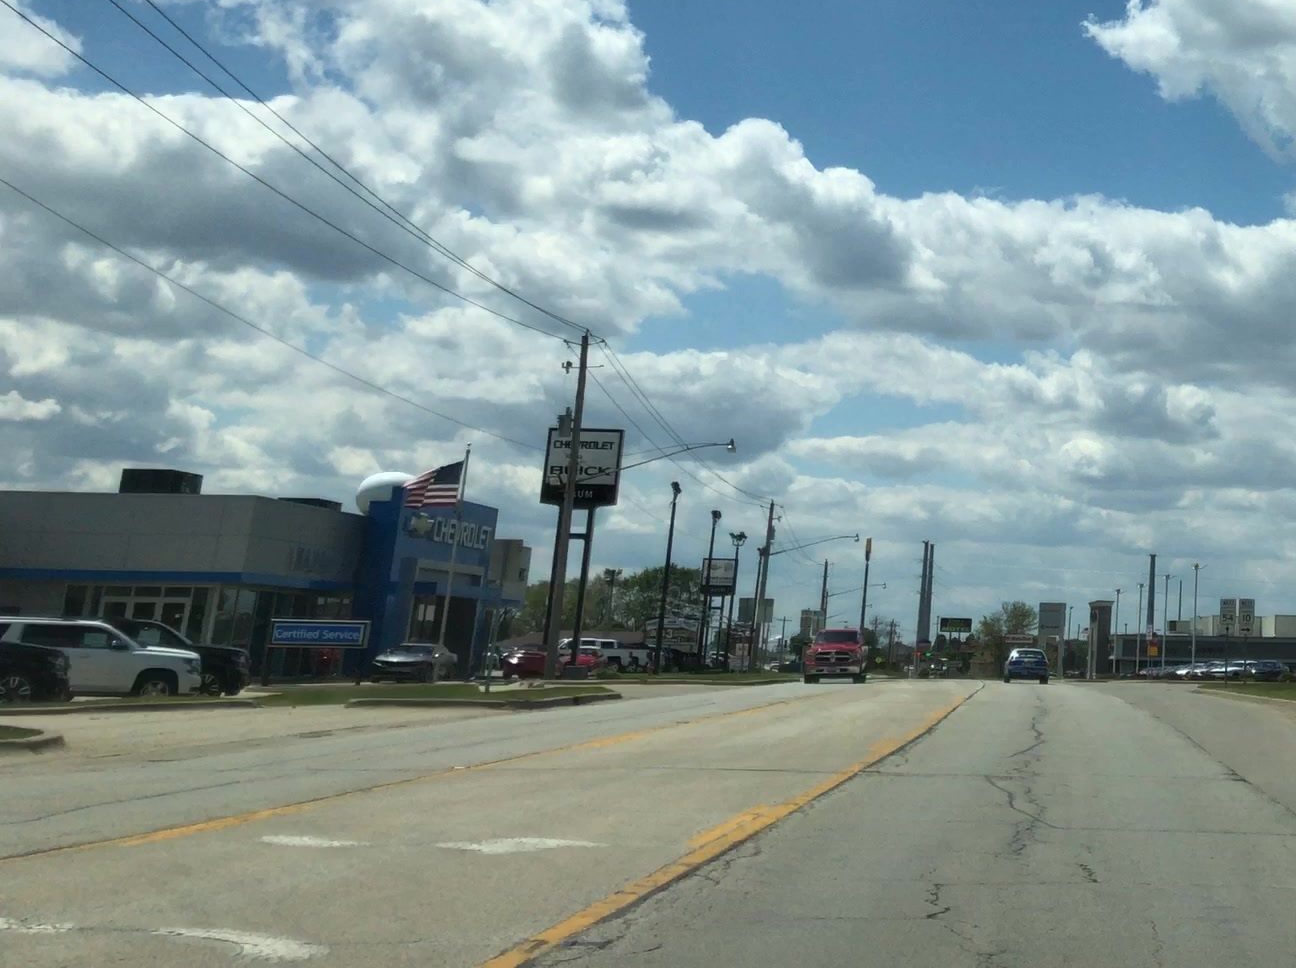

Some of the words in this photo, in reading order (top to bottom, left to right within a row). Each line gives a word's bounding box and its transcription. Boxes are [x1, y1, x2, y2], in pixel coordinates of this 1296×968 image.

[553, 440, 615, 451] CHEROLET
[549, 465, 612, 476] BICK
[1242, 614, 1251, 622] 10
[275, 629, 319, 639] Certified
[322, 630, 360, 640] Service
